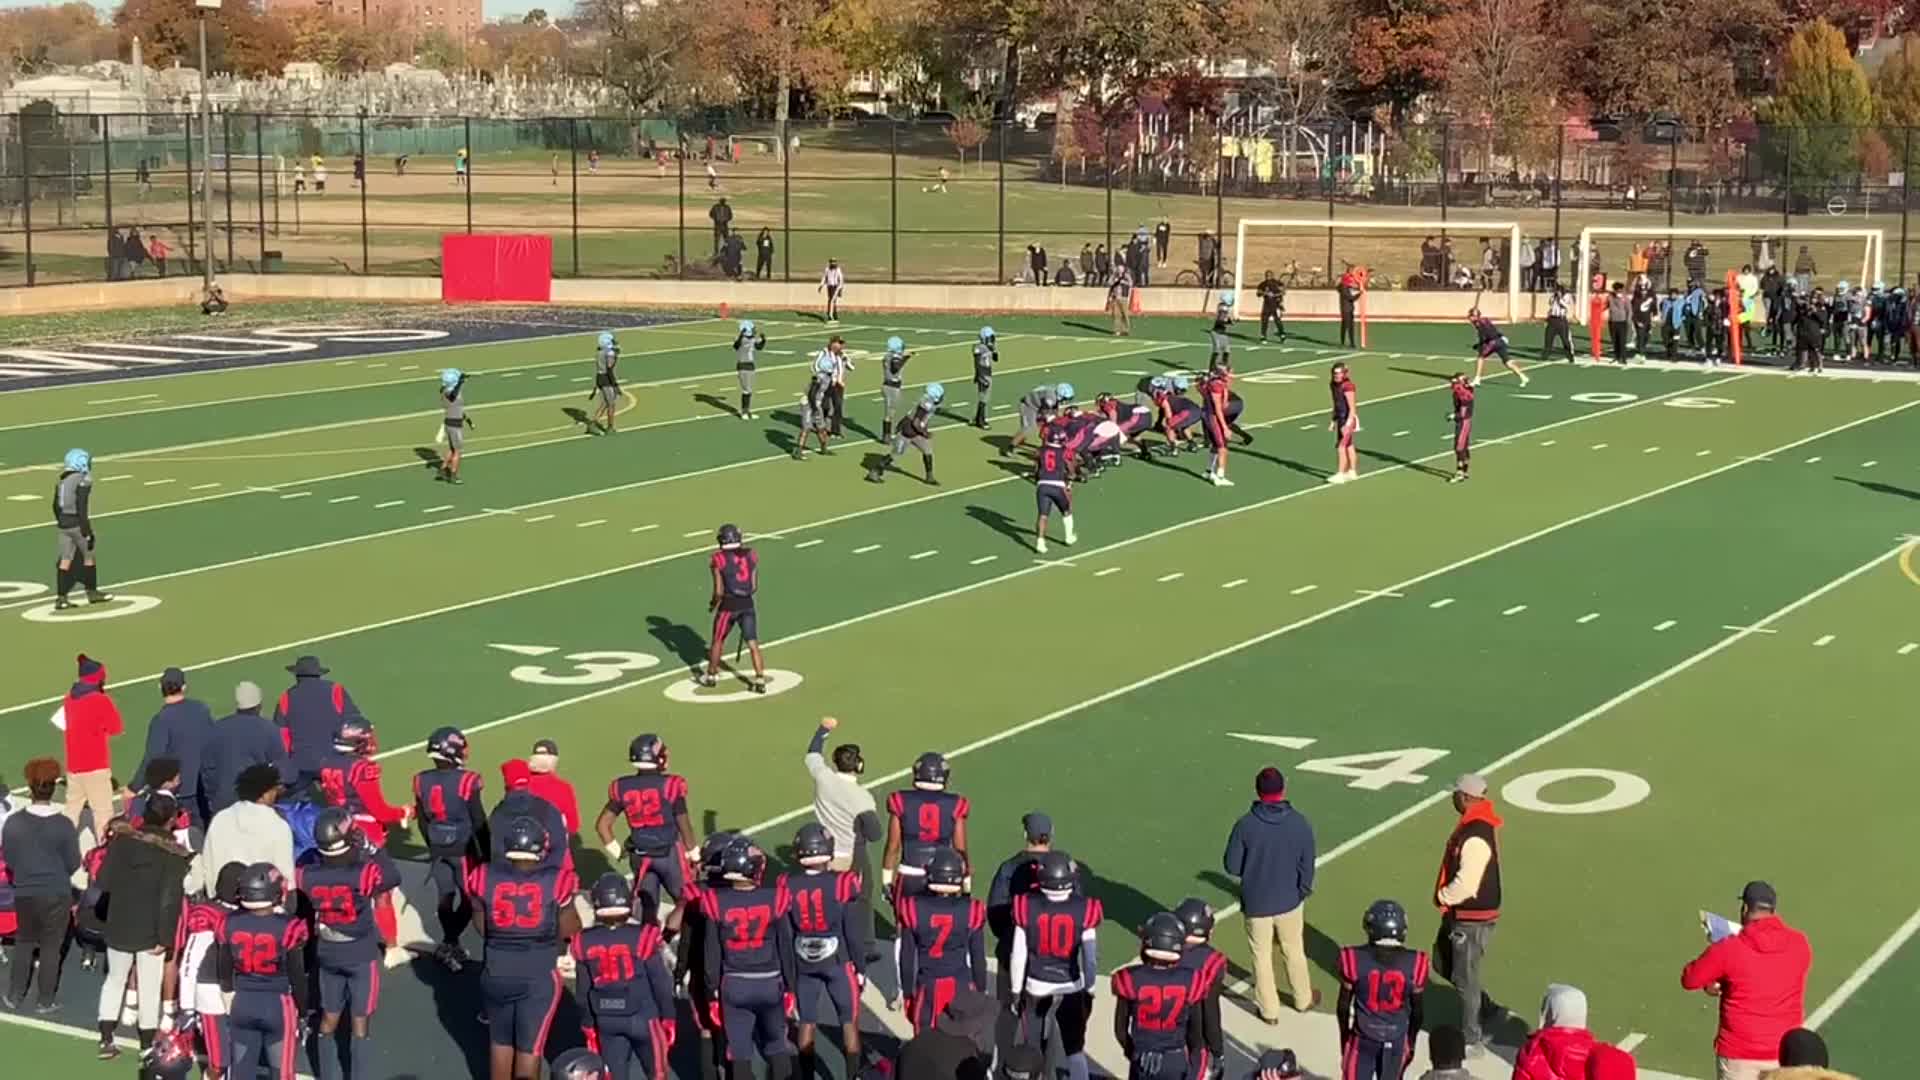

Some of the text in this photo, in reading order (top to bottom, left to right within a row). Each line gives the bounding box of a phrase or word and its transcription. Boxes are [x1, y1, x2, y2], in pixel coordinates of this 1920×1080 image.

[733, 555, 749, 582] 3
[622, 788, 664, 828] 22
[918, 803, 941, 842] 9
[491, 882, 544, 929] 63
[796, 888, 828, 932] 11
[725, 907, 772, 950] 37
[929, 914, 954, 958] 7
[1037, 913, 1075, 958] 10
[1137, 985, 1186, 1031] 27
[1367, 969, 1406, 1014] 13
